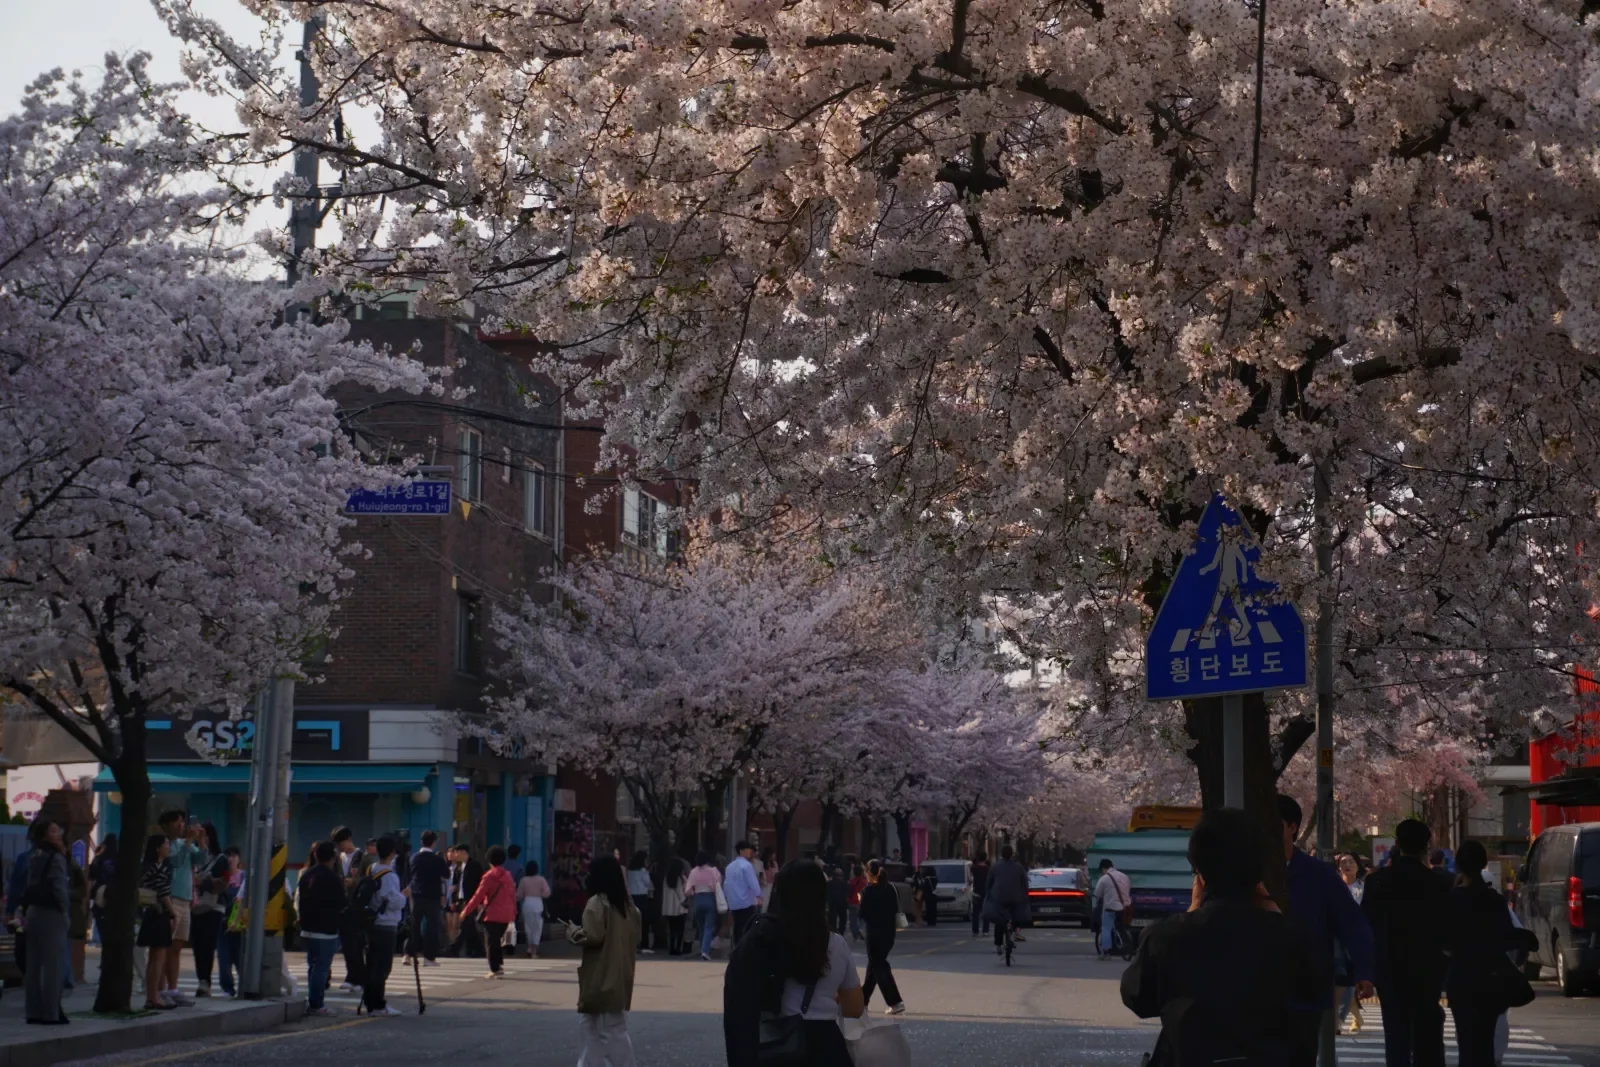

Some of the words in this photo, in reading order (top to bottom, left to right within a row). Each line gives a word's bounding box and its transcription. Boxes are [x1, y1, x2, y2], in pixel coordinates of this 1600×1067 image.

[358, 502, 423, 513] Huiujeong-ro
[425, 502, 447, 513] 1-gil
[1169, 651, 1284, 683] 횡단보도
[190, 719, 255, 750] GS2
